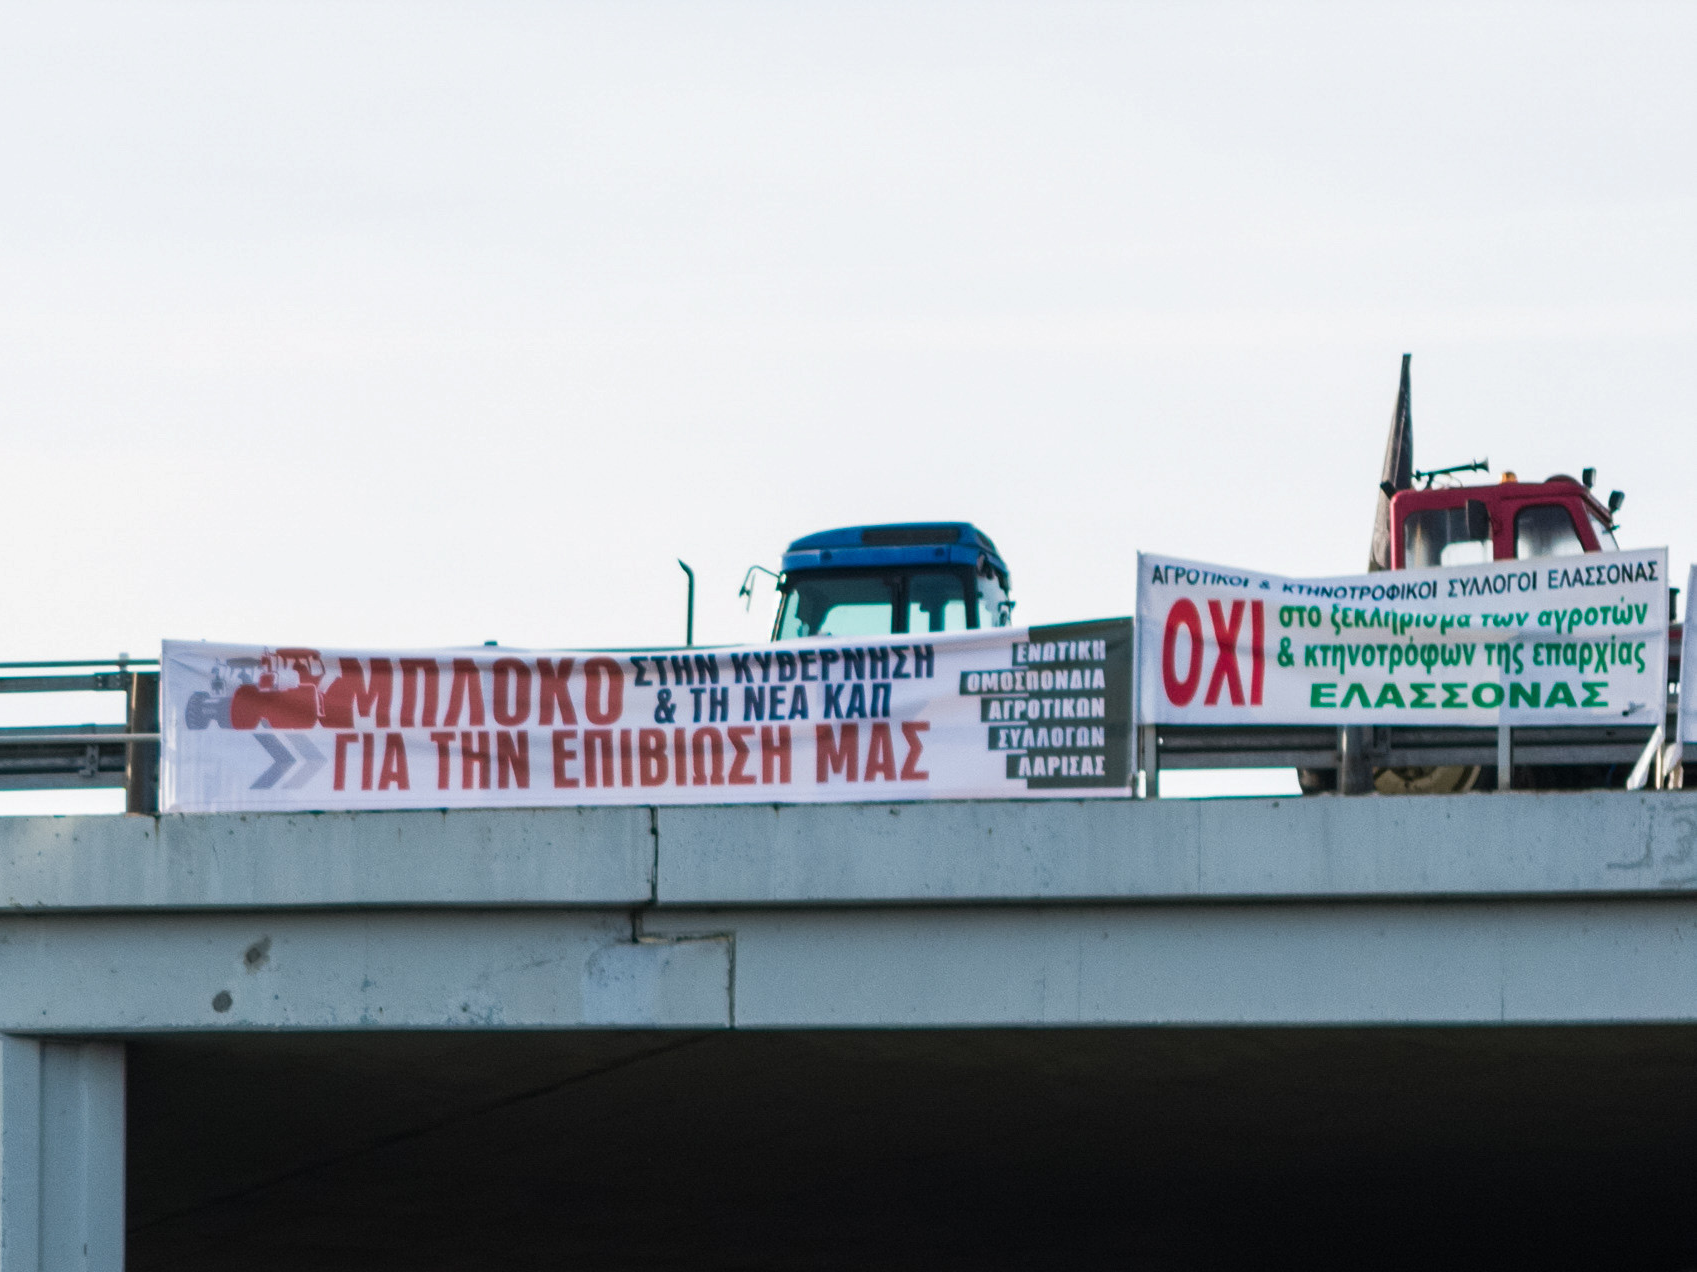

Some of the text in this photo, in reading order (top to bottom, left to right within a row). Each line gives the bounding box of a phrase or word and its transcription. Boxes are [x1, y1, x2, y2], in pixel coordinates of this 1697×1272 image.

[1151, 560, 1659, 601] ΑΓΡΟΤΙΚΟΙ & ΚΤΗΝΟΤΡΟΦΙΚΟΙ ΣΥΛΛΟΓΟΙ ΕΛΑΣΣΟΝΑΣ
[1278, 604, 1322, 628] στο
[1480, 611, 1530, 628] των
[1537, 596, 1649, 635] αγροτών
[630, 644, 935, 687] ΣΤΗΝ ΚΥΒΕΡΝΗΣΗ
[1016, 639, 1106, 663] ΕΝΩΤΙΚΗ
[1162, 597, 1266, 708] ΟΧΙ
[1277, 635, 1646, 675] & κτηνοτρόφων της επαρχίας
[338, 656, 625, 729] ΜΠΛΟΚΟ
[966, 668, 1106, 693] ΟΜΟΣΠΟΝΔΙΑ
[1309, 681, 1610, 709] ΕΛΑΣΣΟΝΑΣ
[654, 682, 892, 724] & ΤΗ ΝΕΑ ΚΑΠ
[988, 697, 1106, 720] ΑΓΡΟΤΙΚΩΝ
[333, 720, 931, 791] ΓΙΑ ΤΗΝ ΕΠΙΒΙΩΣΗ ΜΑΣ
[998, 726, 1106, 748] ΣΥΛΛΟΓΩΝ
[1018, 755, 1106, 777] ΛΑΡΙΣΑΣ
